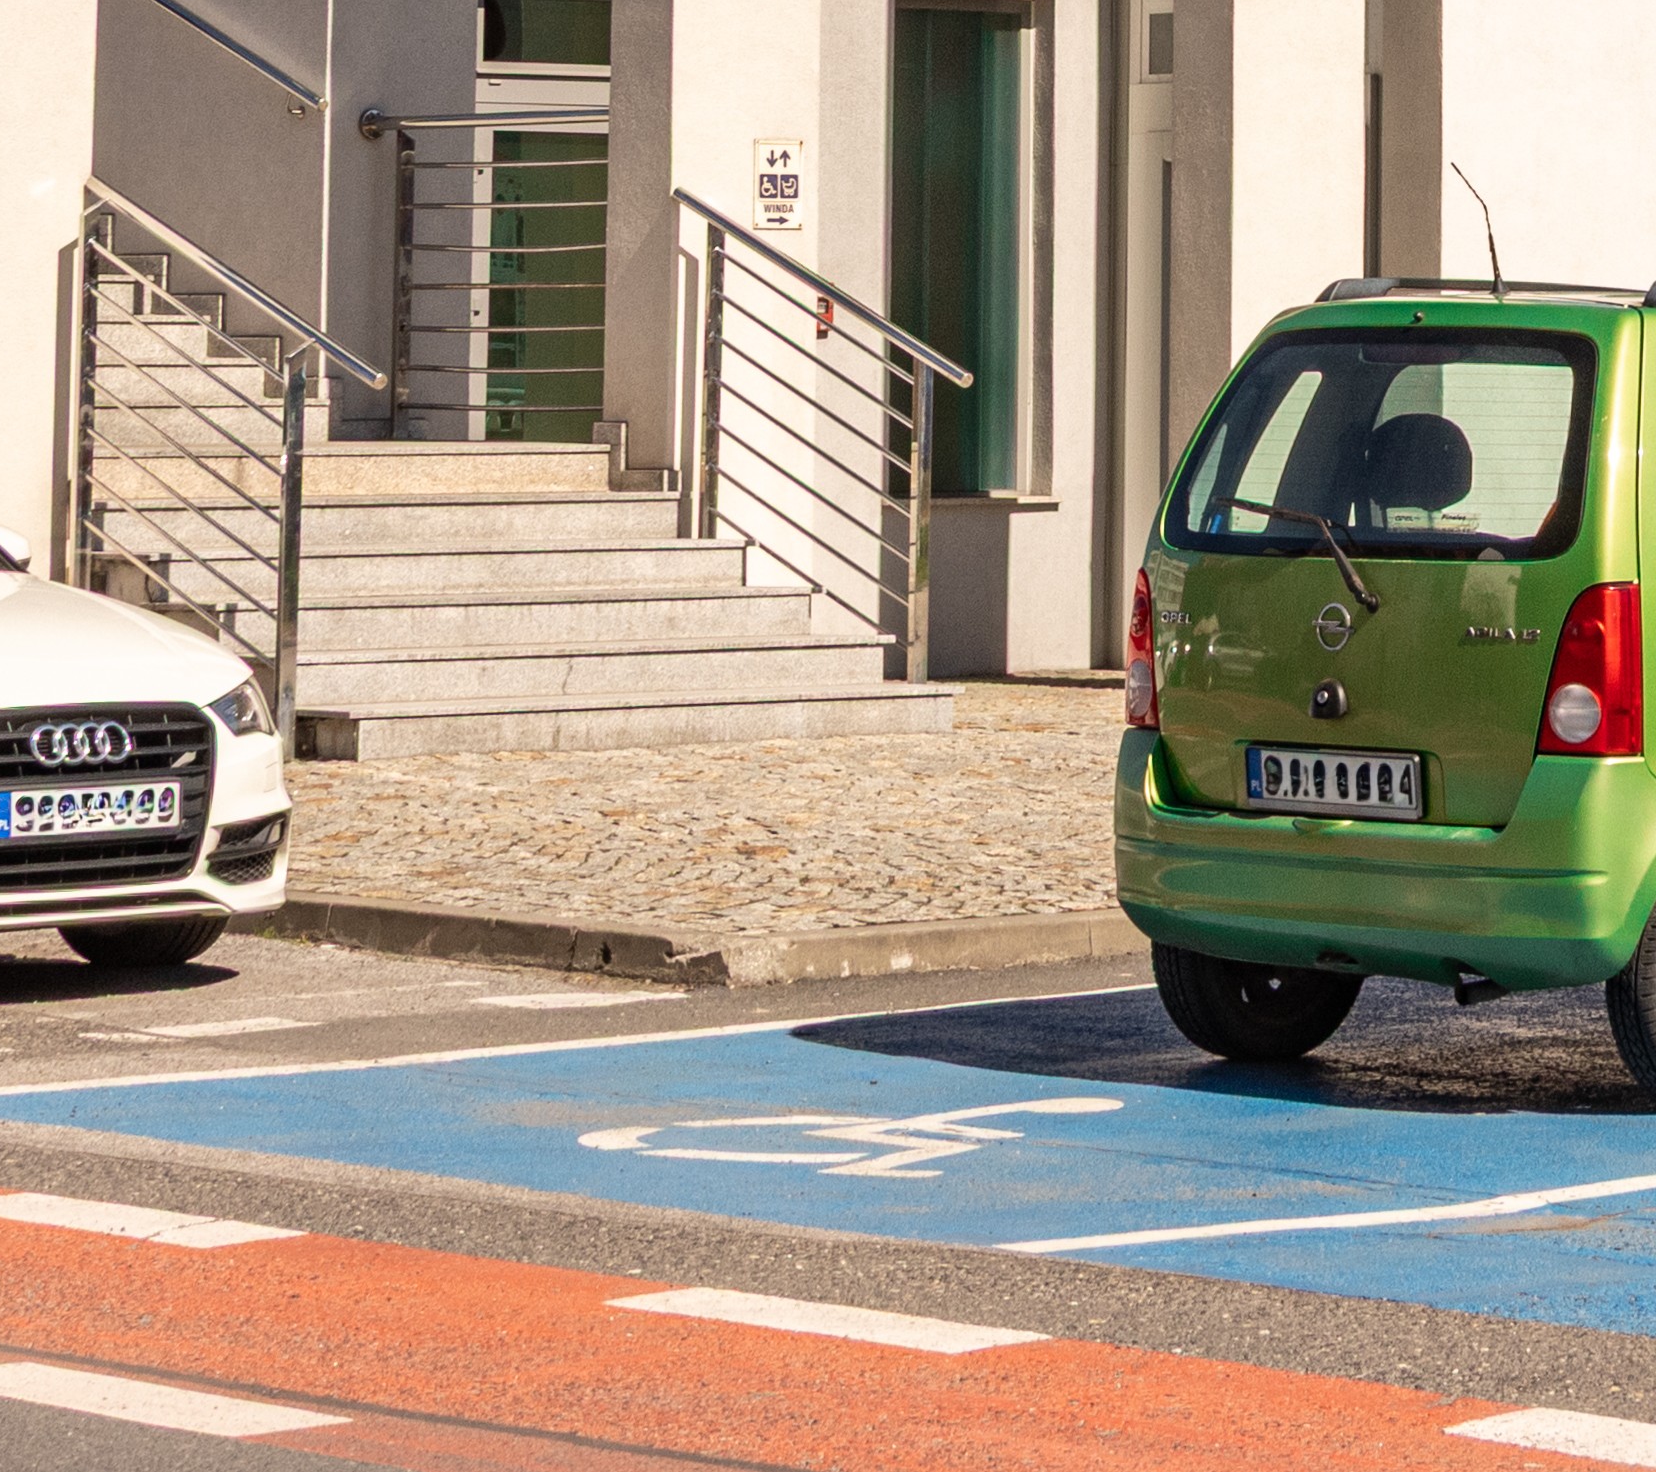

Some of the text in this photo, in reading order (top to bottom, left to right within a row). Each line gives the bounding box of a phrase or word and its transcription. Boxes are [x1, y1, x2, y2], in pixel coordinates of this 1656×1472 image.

[763, 204, 795, 214] WINDA
[1160, 610, 1193, 625] OPEL
[1250, 780, 1262, 792] PL
